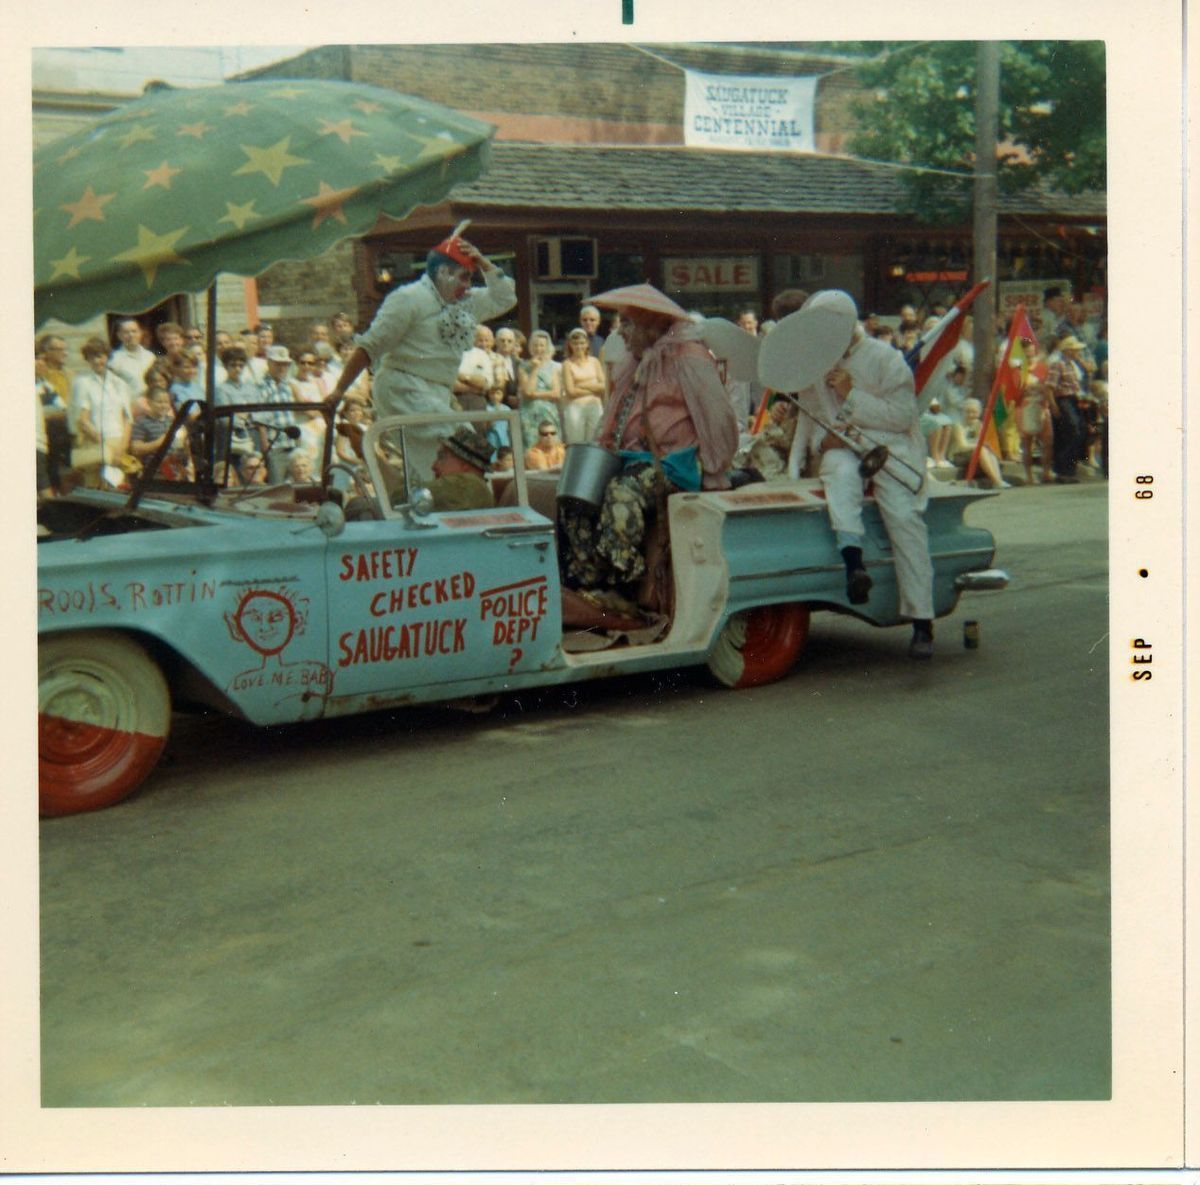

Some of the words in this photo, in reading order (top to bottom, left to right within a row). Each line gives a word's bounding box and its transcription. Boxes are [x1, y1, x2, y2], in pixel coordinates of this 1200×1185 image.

[705, 86, 788, 104] SAUGATUCK
[694, 115, 802, 137] CENTENNIAL
[671, 264, 751, 286] SALE
[339, 547, 418, 582] SAFETY
[370, 571, 475, 617] CHECKED
[480, 585, 548, 620] POLICE
[338, 618, 467, 667] SAUGATUCK
[493, 616, 541, 646] DEPT
[507, 647, 523, 675] ?
